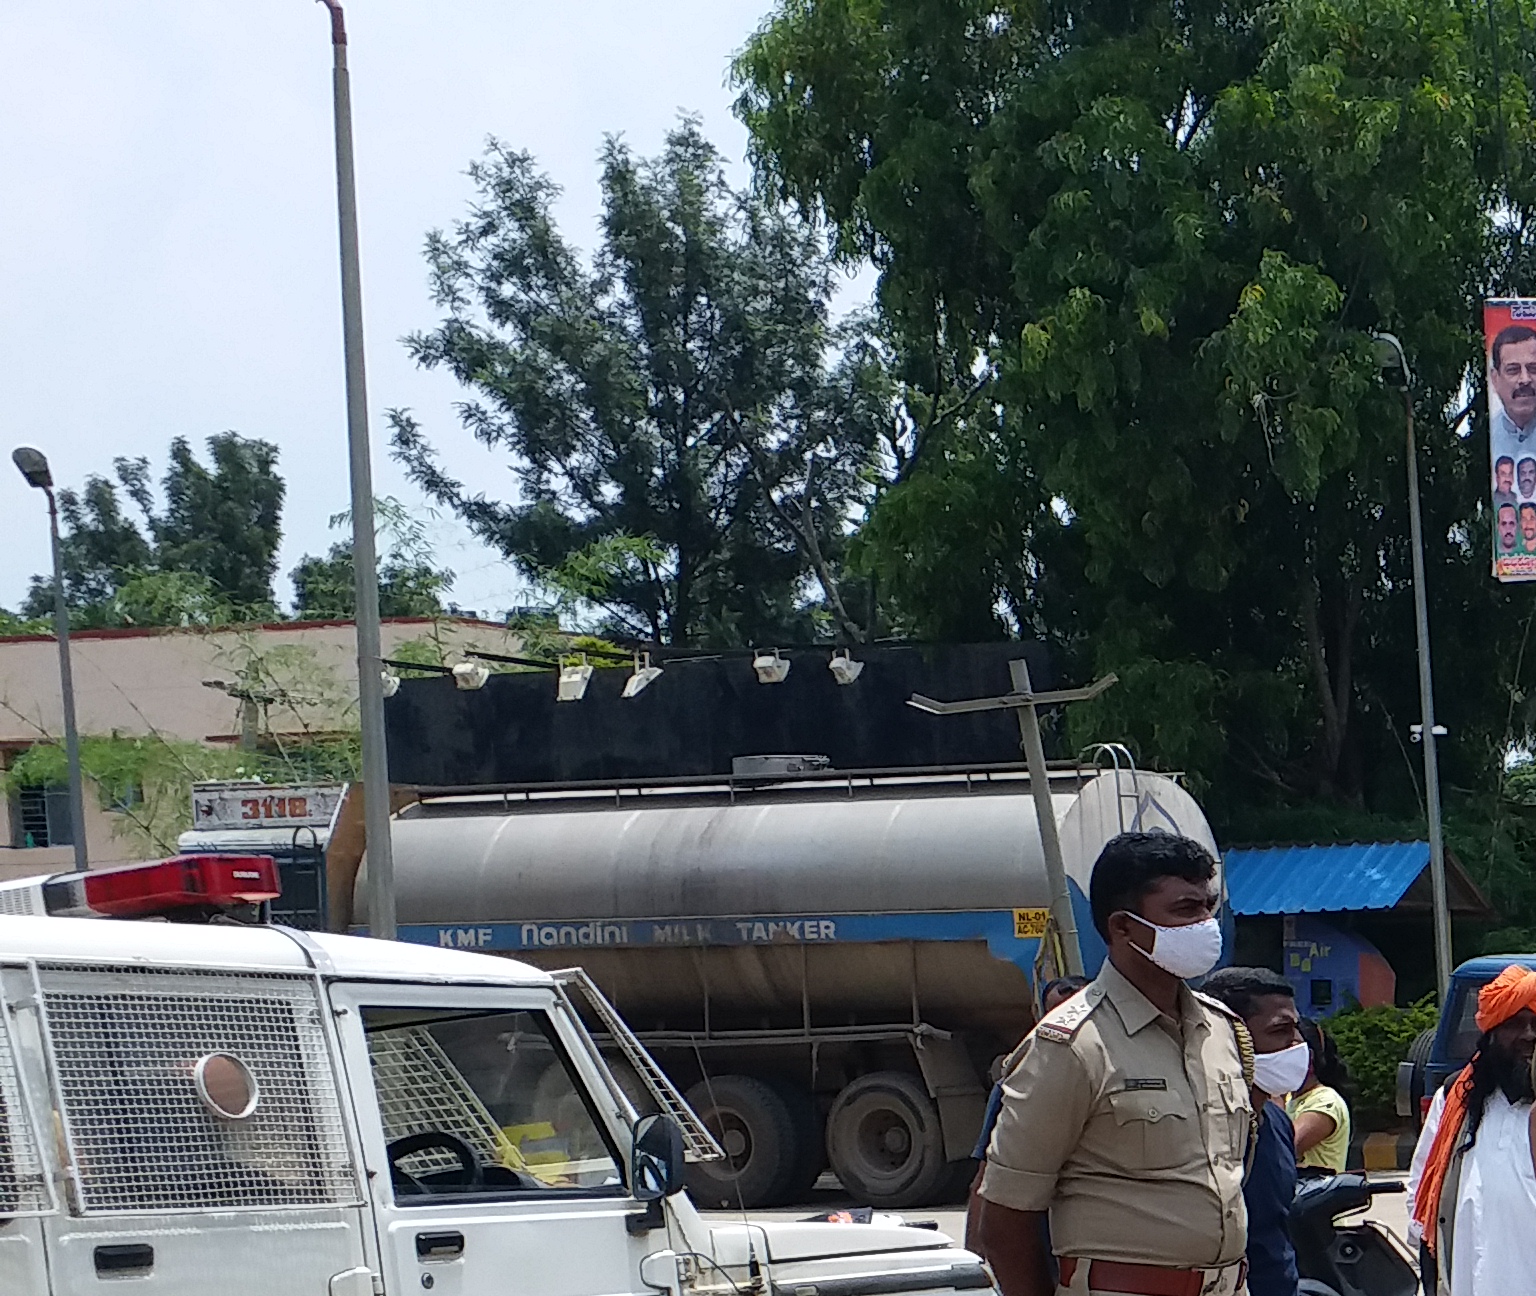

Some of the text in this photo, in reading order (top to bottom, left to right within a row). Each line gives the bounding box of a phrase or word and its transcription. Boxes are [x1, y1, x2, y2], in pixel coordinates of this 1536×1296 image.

[1018, 911, 1046, 921] NL-01
[438, 928, 494, 948] KMF
[735, 919, 838, 942] TANKER
[1309, 943, 1332, 957] Air
